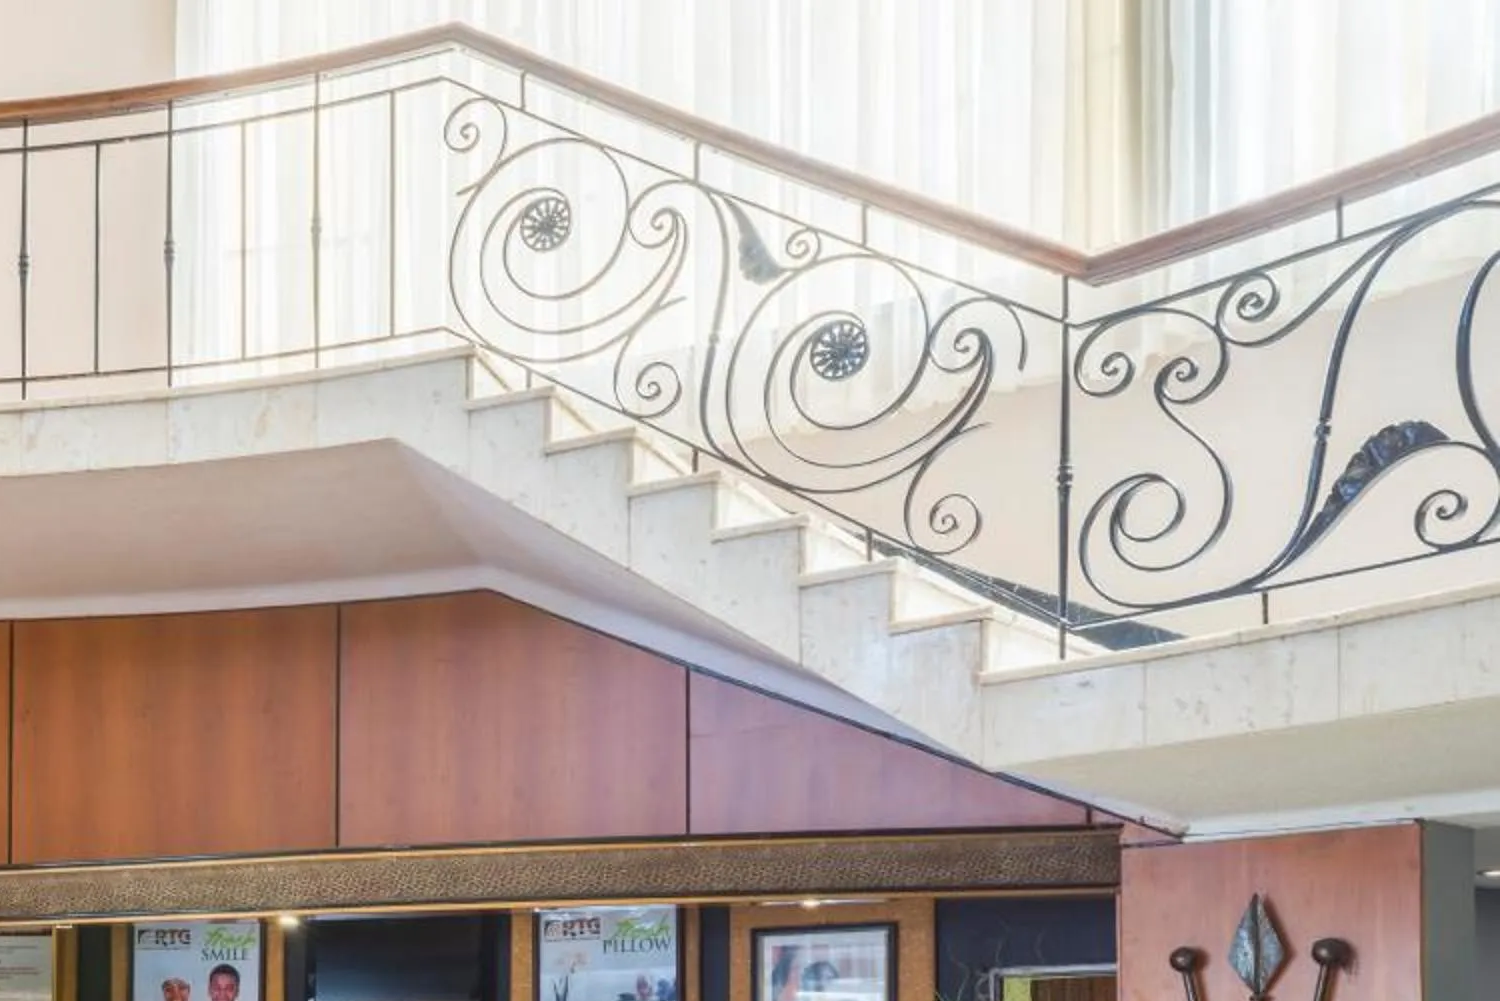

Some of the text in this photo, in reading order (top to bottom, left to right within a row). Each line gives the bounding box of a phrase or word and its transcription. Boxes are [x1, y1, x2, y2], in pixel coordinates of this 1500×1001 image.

[562, 917, 601, 938] RTG
[155, 928, 192, 948] RTG
[603, 937, 672, 954] PILLOW
[201, 947, 251, 961] SMILE
